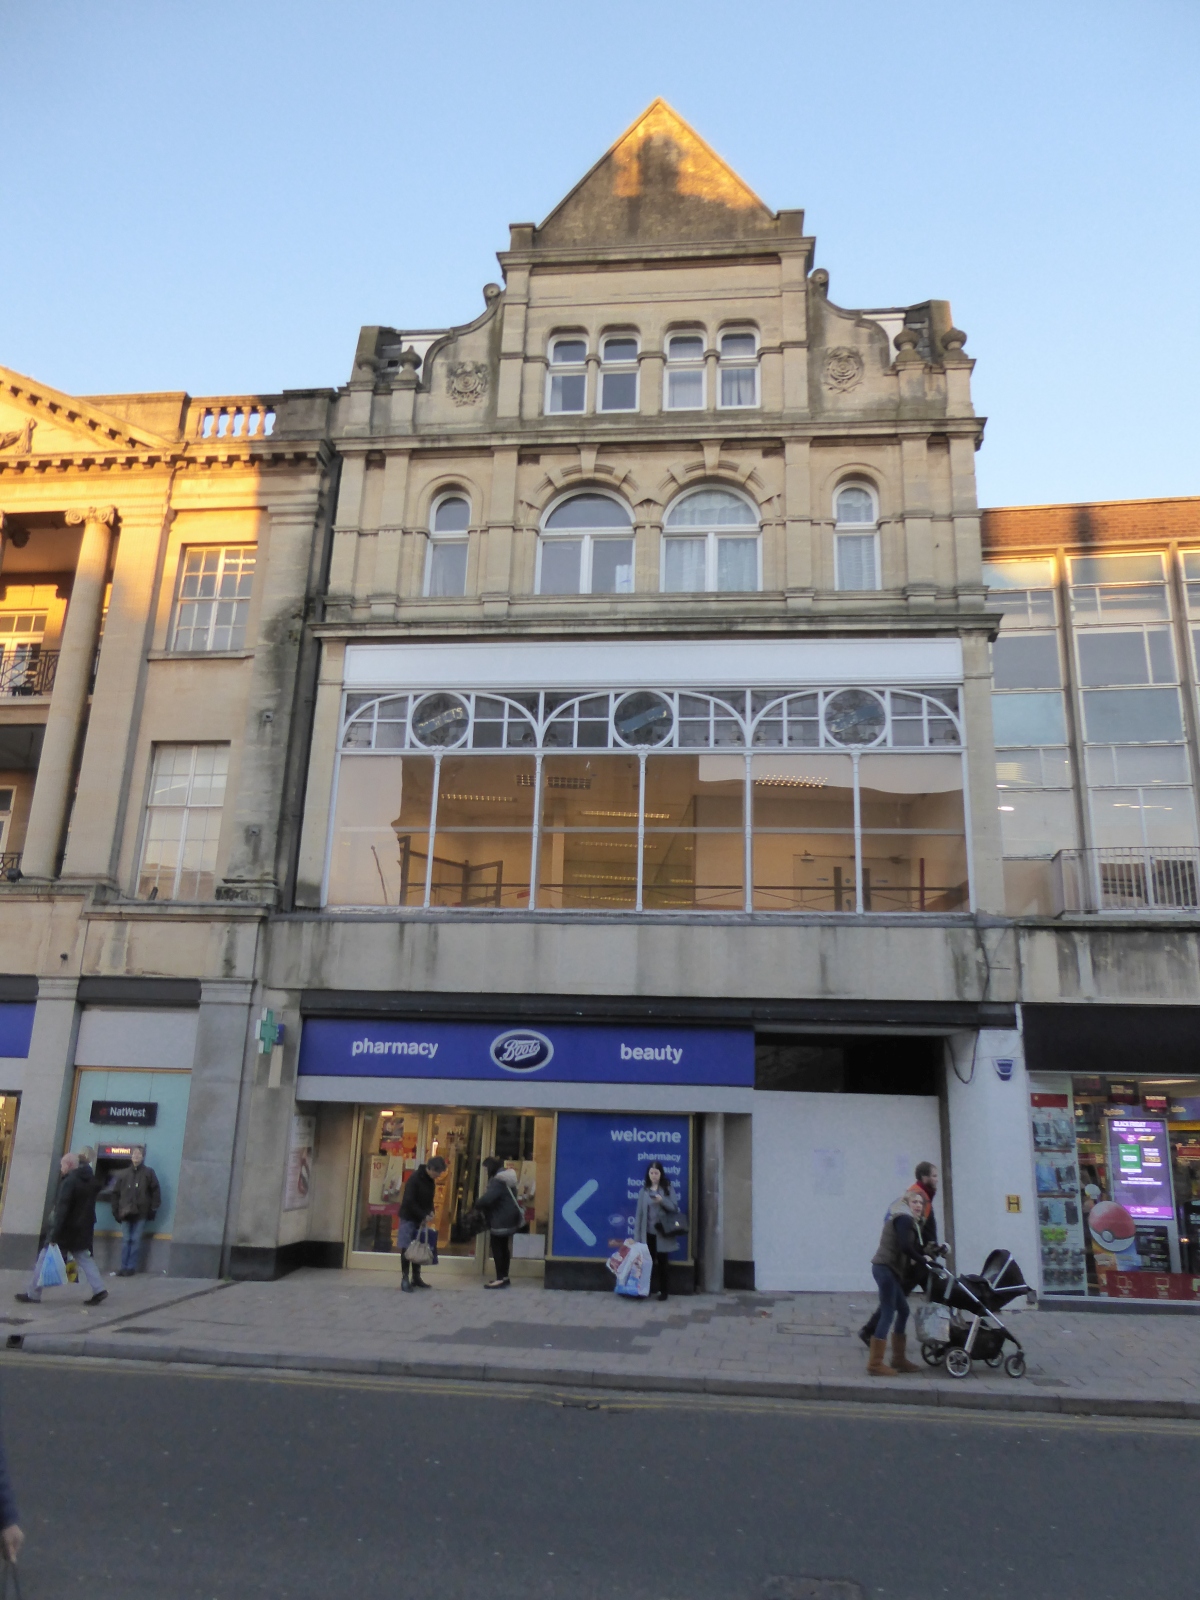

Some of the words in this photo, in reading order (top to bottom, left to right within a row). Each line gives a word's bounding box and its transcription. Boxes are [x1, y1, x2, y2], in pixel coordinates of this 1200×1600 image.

[352, 1037, 439, 1059] pharmacy
[499, 1039, 541, 1062] Boots
[620, 1043, 683, 1065] beauty
[109, 1106, 147, 1118] NatWest
[610, 1127, 682, 1143] welcome
[111, 1147, 131, 1155] NatWest
[637, 1151, 682, 1163] pharmacy
[662, 1165, 682, 1176] auty
